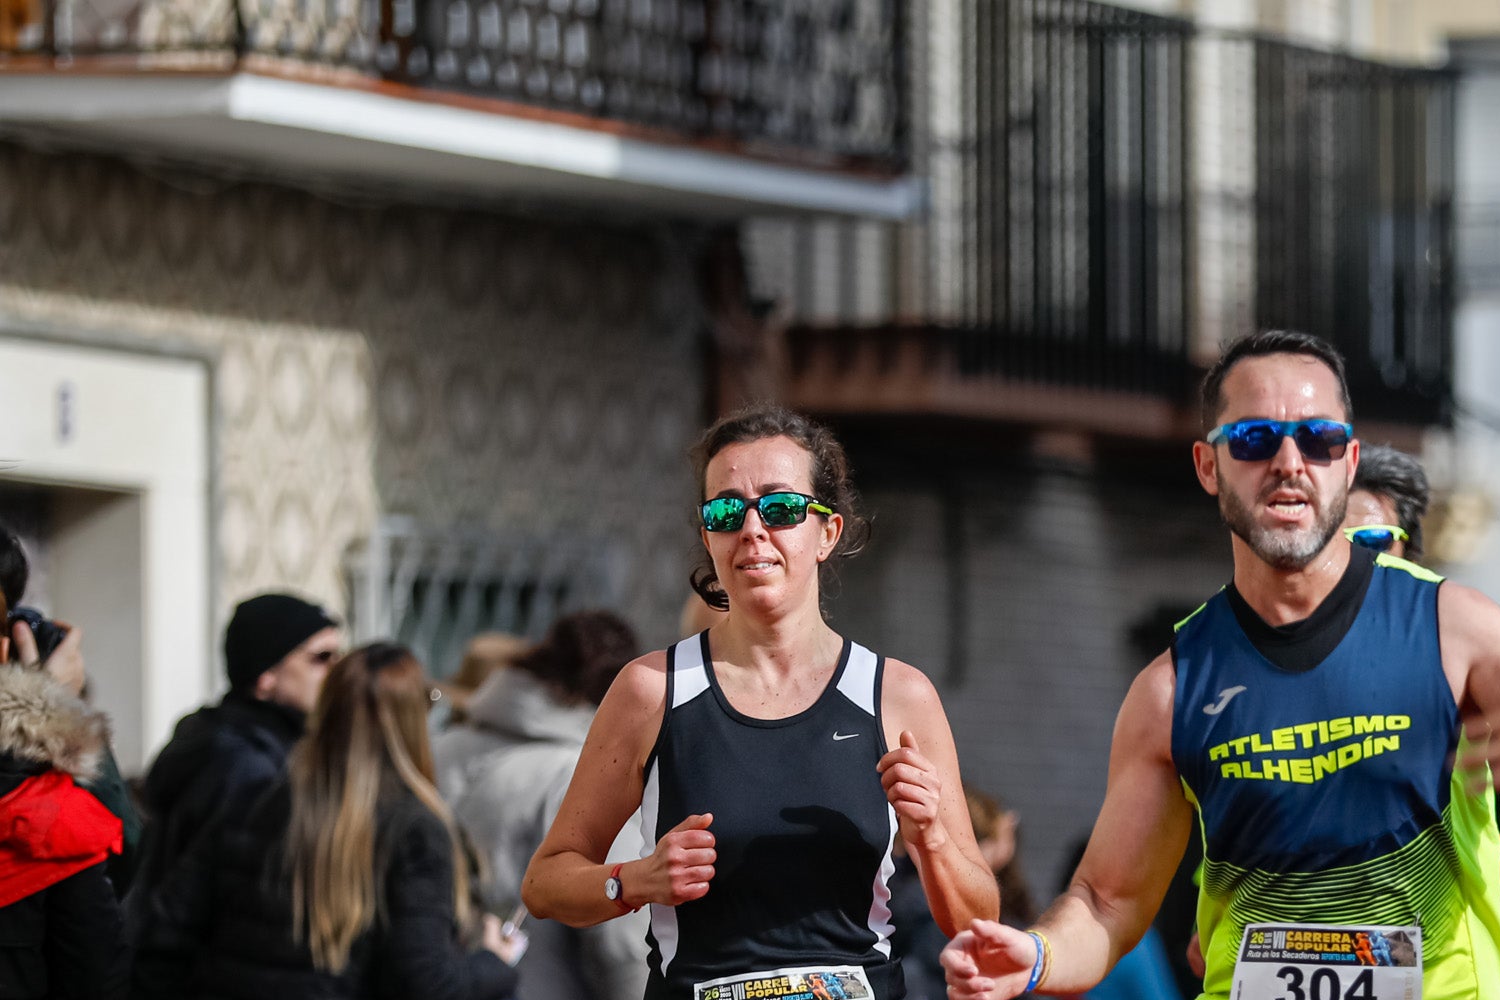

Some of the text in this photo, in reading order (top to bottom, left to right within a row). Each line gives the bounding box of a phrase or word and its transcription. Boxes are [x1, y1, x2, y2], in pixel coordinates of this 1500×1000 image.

[1209, 715, 1411, 761] ATLETISMO
[1220, 735, 1400, 784] ALHENDÍN
[1250, 932, 1264, 944] 26
[1286, 931, 1351, 944] CARRERA
[1286, 942, 1351, 952] POPULAR
[1270, 950, 1280, 958] los
[1282, 951, 1320, 960] Secaderos
[745, 975, 806, 991] CARREA
[704, 987, 719, 1000] 26
[731, 983, 745, 1000] VII
[746, 985, 808, 999] POPULAR
